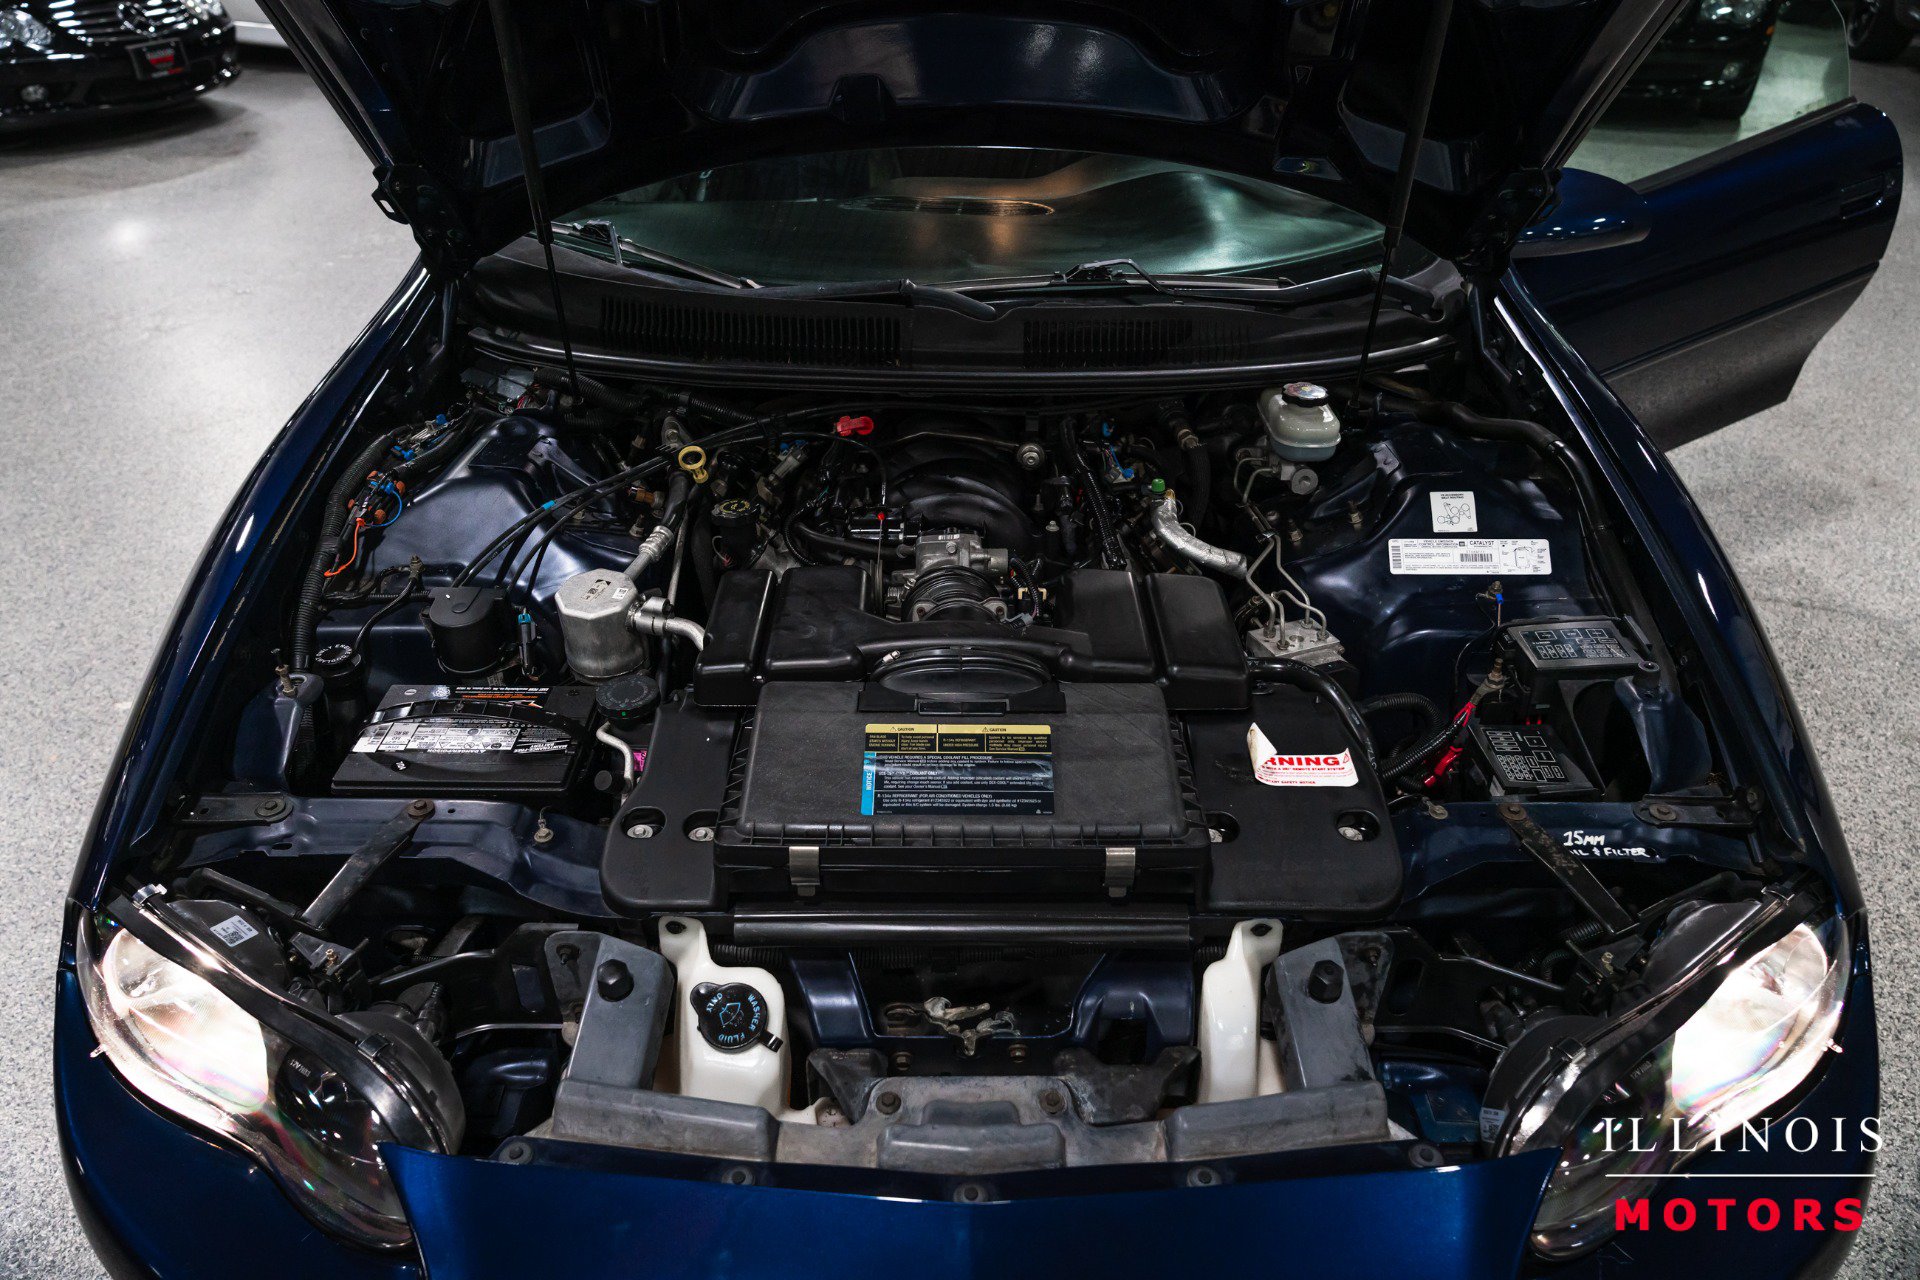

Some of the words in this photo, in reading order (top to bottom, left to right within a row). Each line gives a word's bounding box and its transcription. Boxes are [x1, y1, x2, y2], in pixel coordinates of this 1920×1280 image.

[1264, 757, 1340, 766] RNING
[1563, 830, 1605, 846] 15MM
[1604, 847, 1650, 858] FILTER
[706, 992, 723, 1014] ONLY
[748, 994, 761, 1032] WASHER
[718, 1032, 746, 1044] FLUID
